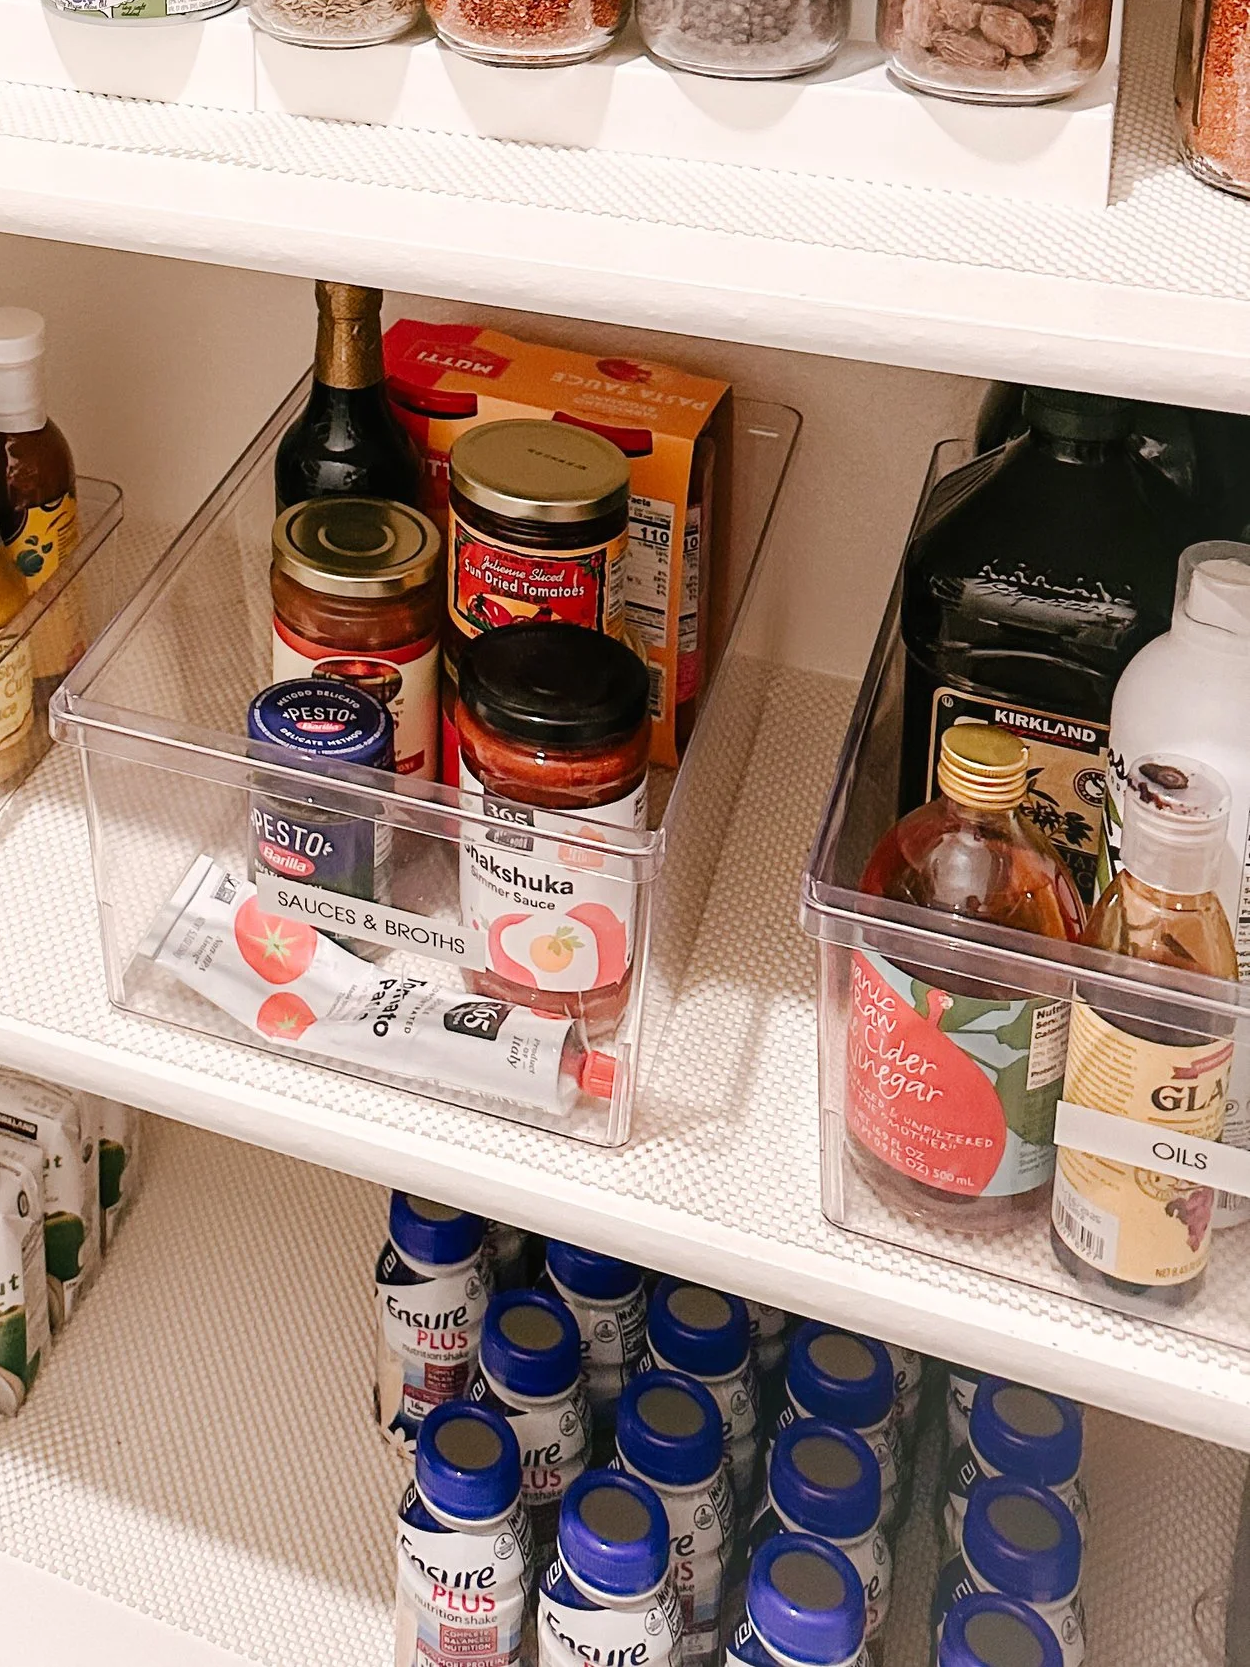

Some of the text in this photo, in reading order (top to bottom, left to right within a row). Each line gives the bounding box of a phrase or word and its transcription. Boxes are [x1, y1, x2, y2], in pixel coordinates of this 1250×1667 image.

[417, 351, 494, 375] MUTTI
[640, 526, 669, 544] 110
[464, 558, 585, 599] Sun Dried Tomatoes
[481, 556, 565, 583] Julienne Sliced
[277, 690, 360, 709] METODO DELICATO
[287, 707, 350, 722] PESTO
[302, 722, 339, 731] Barilla
[995, 709, 1097, 743] KIRKLAND
[279, 727, 324, 746] DELICATE
[253, 808, 324, 857] PESTO
[264, 846, 307, 873] Barilla
[513, 893, 555, 911] Sauce
[278, 891, 466, 955] SAUCES & BROTHS
[506, 1035, 523, 1070] Italy
[865, 1025, 938, 1076] Cider
[852, 1046, 944, 1103] Vinegar
[903, 1117, 994, 1148] UNFILTERED
[891, 1136, 926, 1161] FL OZ
[1152, 1142, 1208, 1170] OILS
[890, 1149, 975, 1187] FL 500 mL
[386, 1295, 469, 1330] Ensure
[417, 1330, 469, 1350] PLUS
[442, 1349, 469, 1360] shake
[401, 1534, 496, 1590] Ensure
[432, 1584, 496, 1613] PLUS
[443, 1629, 490, 1638] COMPLETE
[464, 1614, 498, 1626] shake
[443, 1636, 490, 1645] BALANCED
[443, 1643, 491, 1652] NUTRITION
